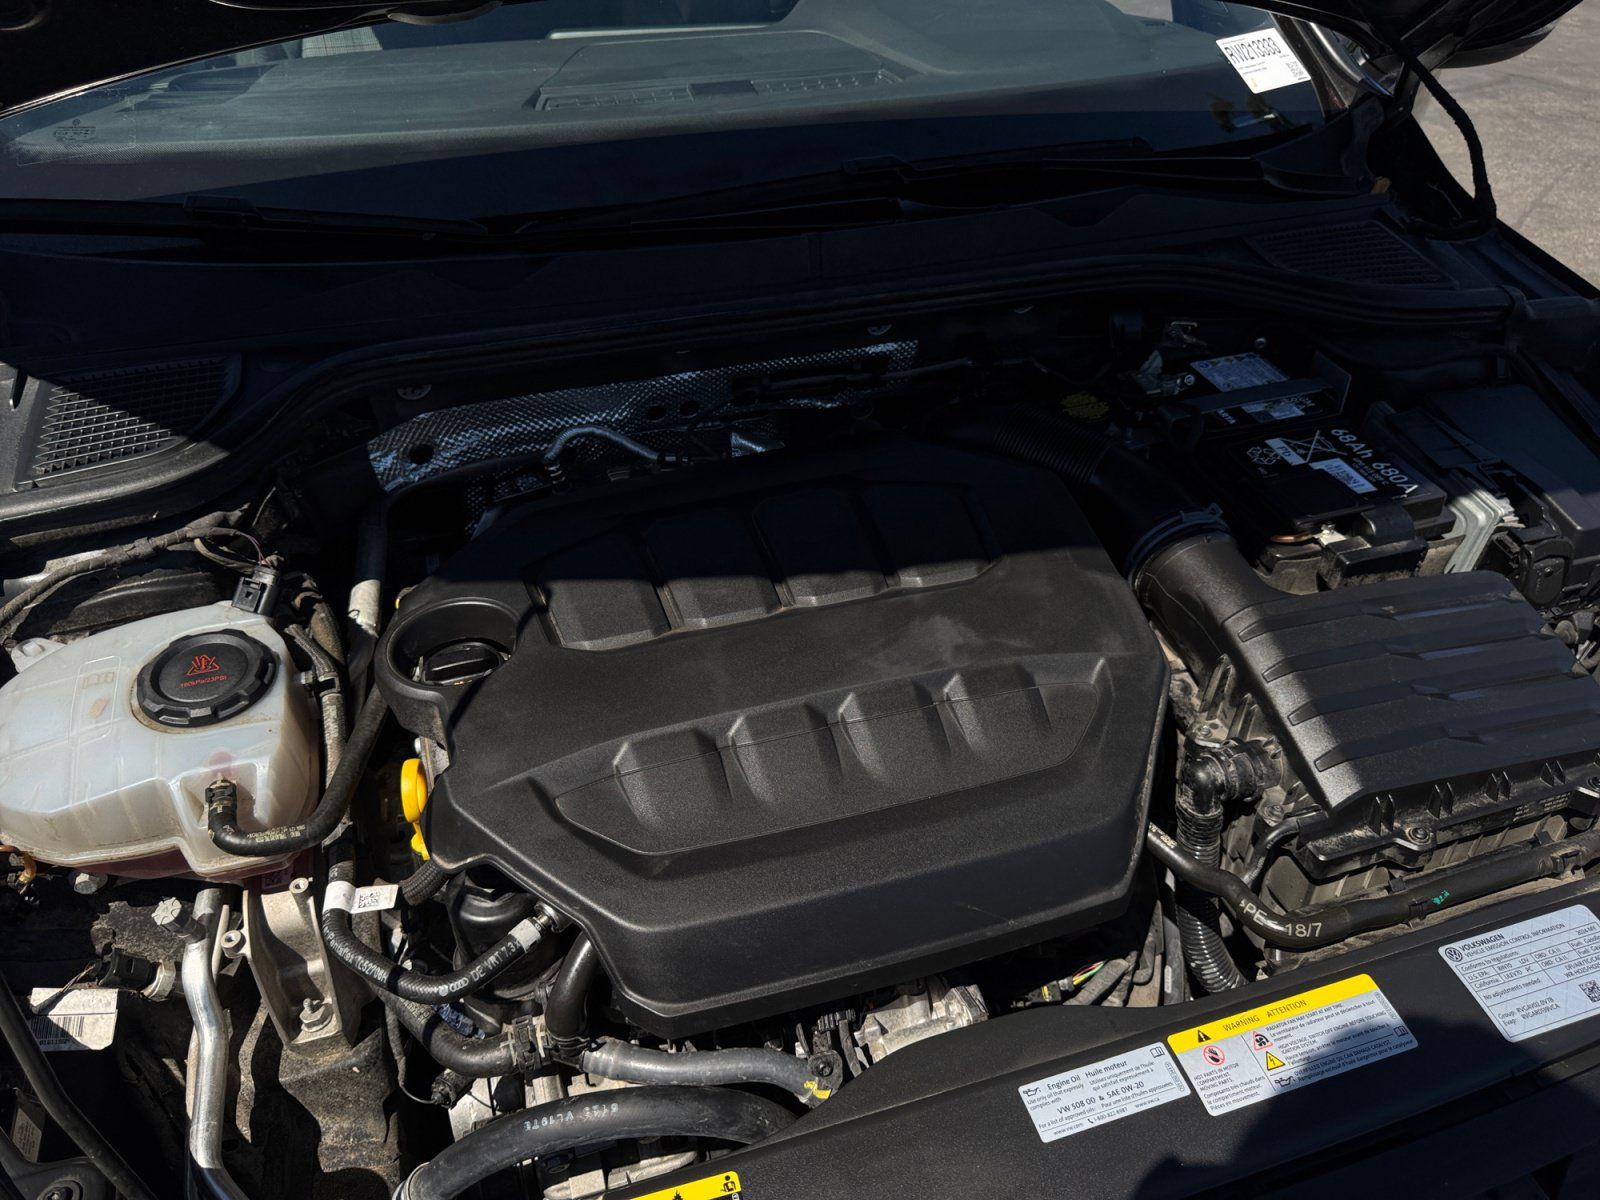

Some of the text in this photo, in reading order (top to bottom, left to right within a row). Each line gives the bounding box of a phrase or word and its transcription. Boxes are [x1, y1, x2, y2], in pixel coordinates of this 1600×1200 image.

[1224, 37, 1281, 64] RW213333
[1331, 429, 1374, 459] 68Ah
[1371, 462, 1418, 494] 680A
[1285, 922, 1322, 938] 18/7
[1458, 935, 1503, 951] VOLKSWAGEN
[1464, 923, 1565, 957] VEHICLE EMISSION CONTROL INFORMATION
[1222, 1000, 1306, 1030] WARNING ATTENTION
[1047, 1074, 1080, 1090] Engine Oil
[1085, 1061, 1126, 1077] Huile moteur
[1056, 1105, 1070, 1114] VW
[1071, 1100, 1085, 1109] 508
[1085, 1096, 1096, 1105] 00
[1106, 1088, 1120, 1097] SAE
[1120, 1081, 1144, 1093] 0W-20
